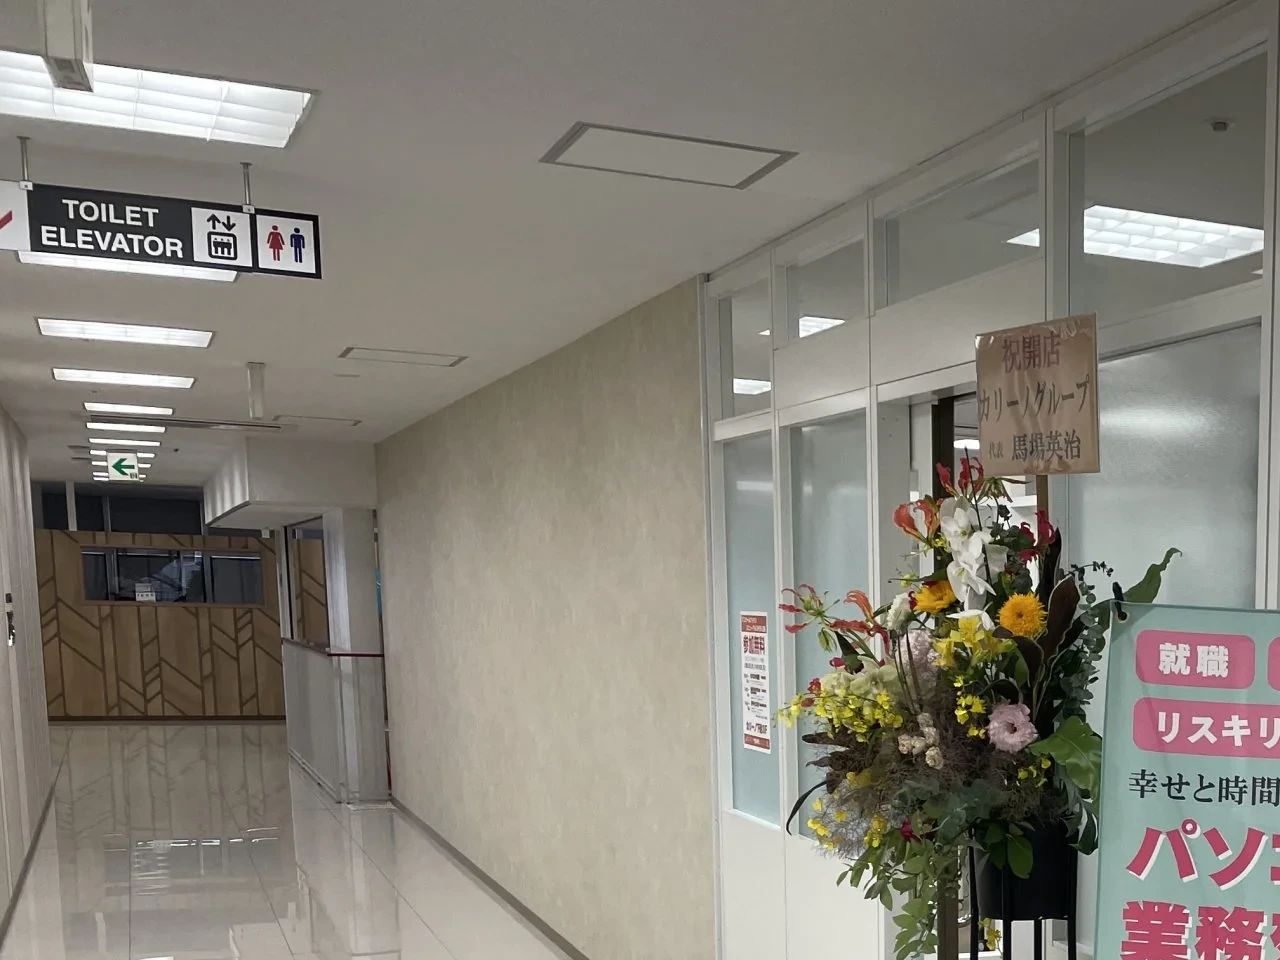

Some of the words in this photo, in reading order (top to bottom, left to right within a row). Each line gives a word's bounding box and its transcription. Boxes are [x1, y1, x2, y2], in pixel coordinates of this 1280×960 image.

[62, 199, 159, 228] TOILET
[41, 226, 183, 258] ELEVATOR
[1002, 332, 1061, 373] 祝開店
[980, 374, 1090, 422] カリーノグループ
[1159, 643, 1230, 678] 就職
